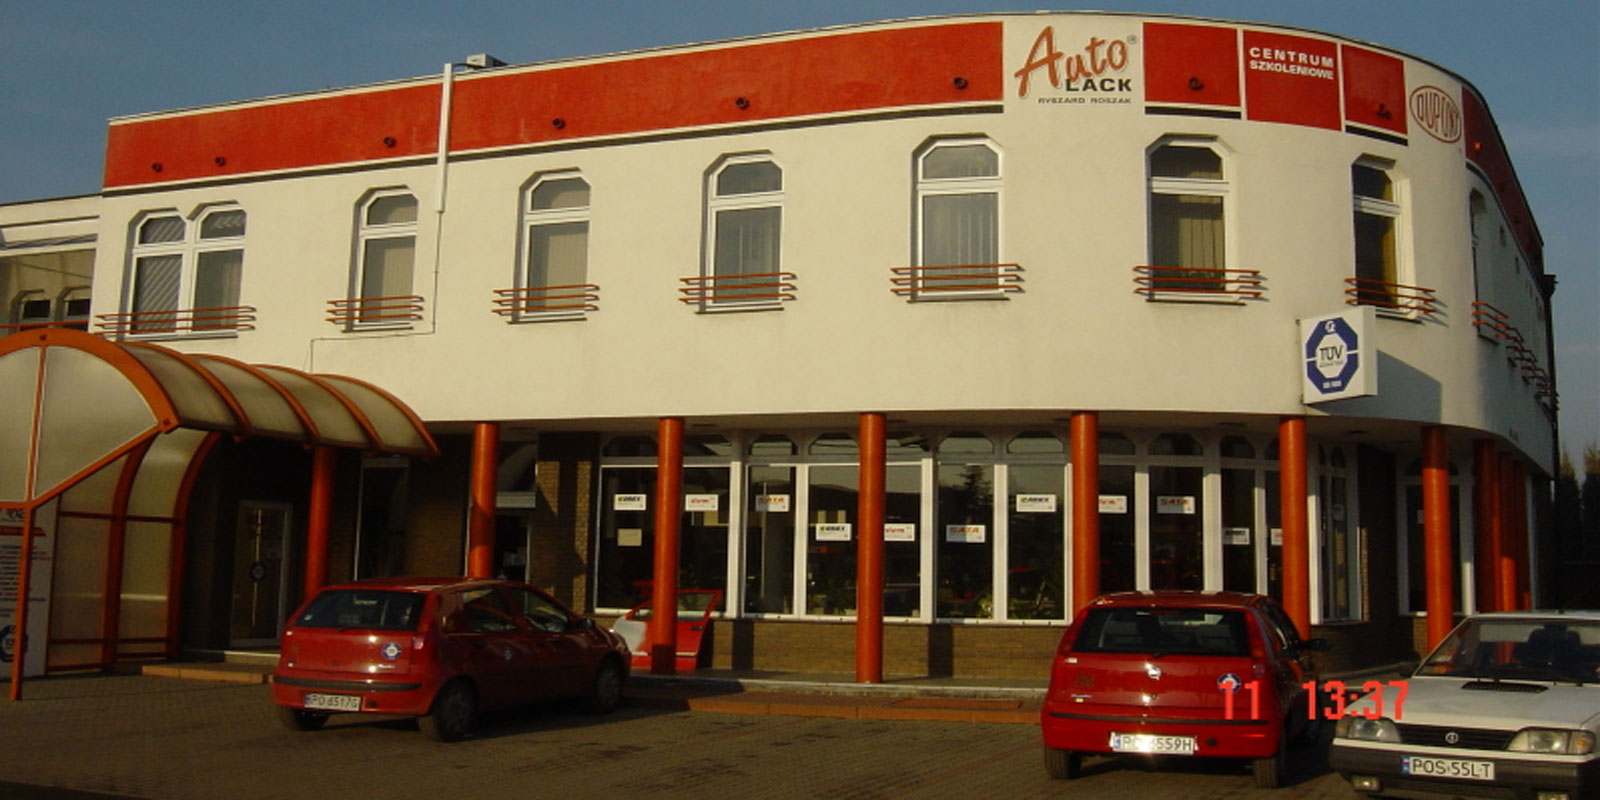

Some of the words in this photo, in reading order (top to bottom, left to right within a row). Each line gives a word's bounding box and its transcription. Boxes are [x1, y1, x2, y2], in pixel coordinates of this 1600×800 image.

[1014, 25, 1128, 97] Auto
[1249, 47, 1335, 68] CENTRUM
[1249, 60, 1335, 80] SZKOLENIOWE
[1065, 78, 1132, 92] LACK
[1038, 97, 1086, 105] RYSZARD
[1090, 97, 1132, 105] ROSZAK
[1412, 758, 1447, 775] POS
